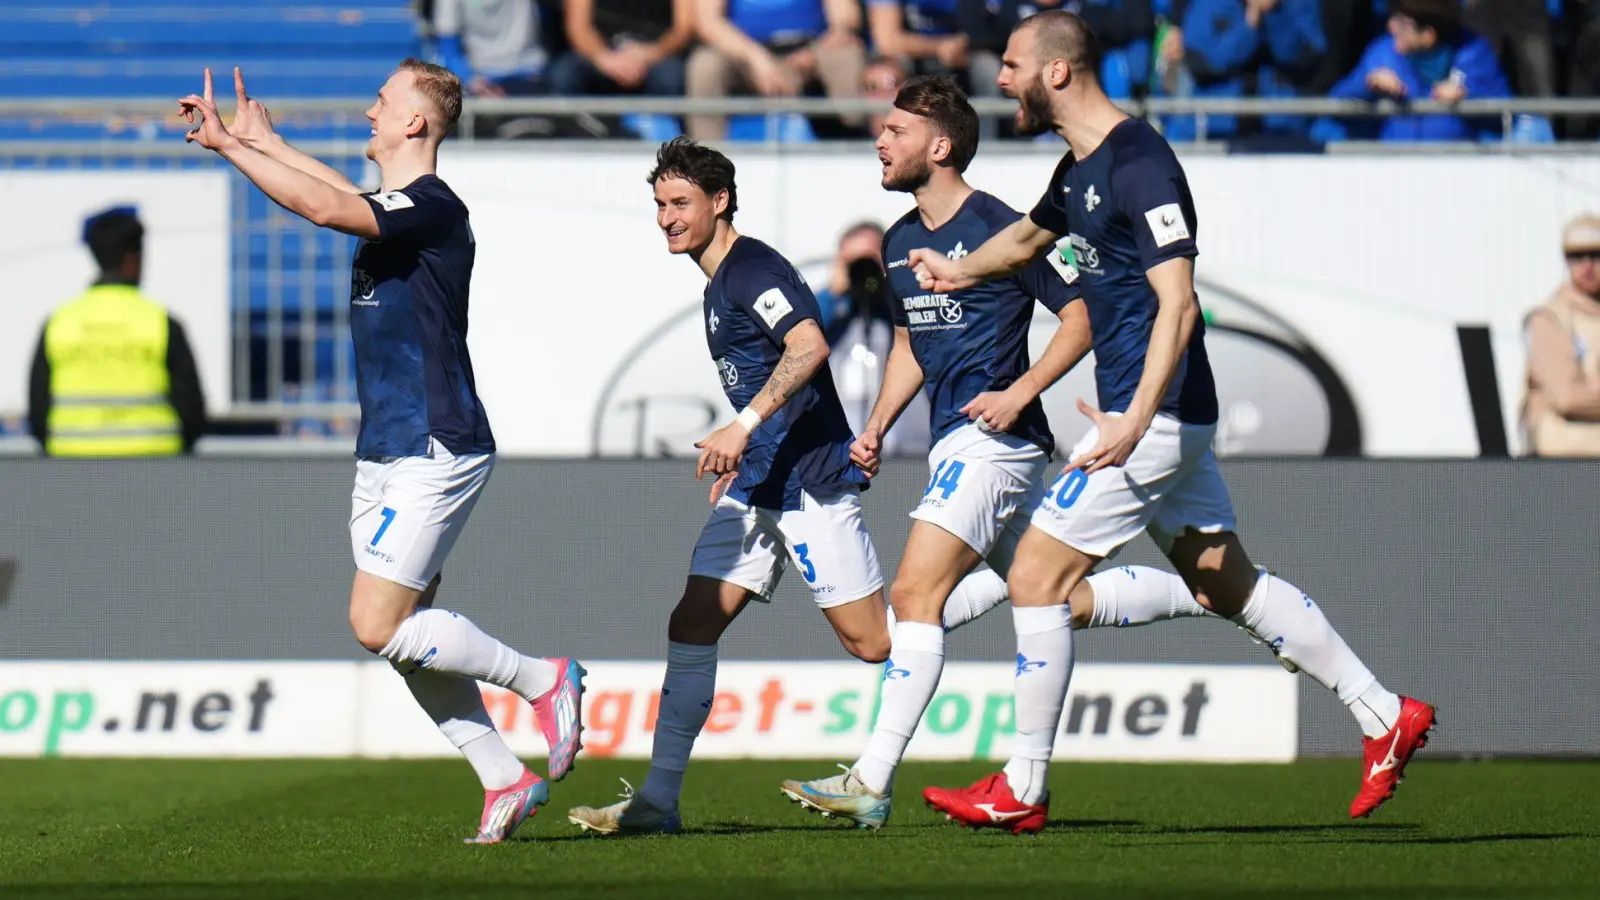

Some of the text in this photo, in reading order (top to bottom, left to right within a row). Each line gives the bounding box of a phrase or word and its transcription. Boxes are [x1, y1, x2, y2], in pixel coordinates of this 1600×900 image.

[925, 459, 965, 500] 34
[370, 507, 397, 546] 7
[793, 543, 817, 583] 3
[482, 677, 1210, 759] mget-sopnet
